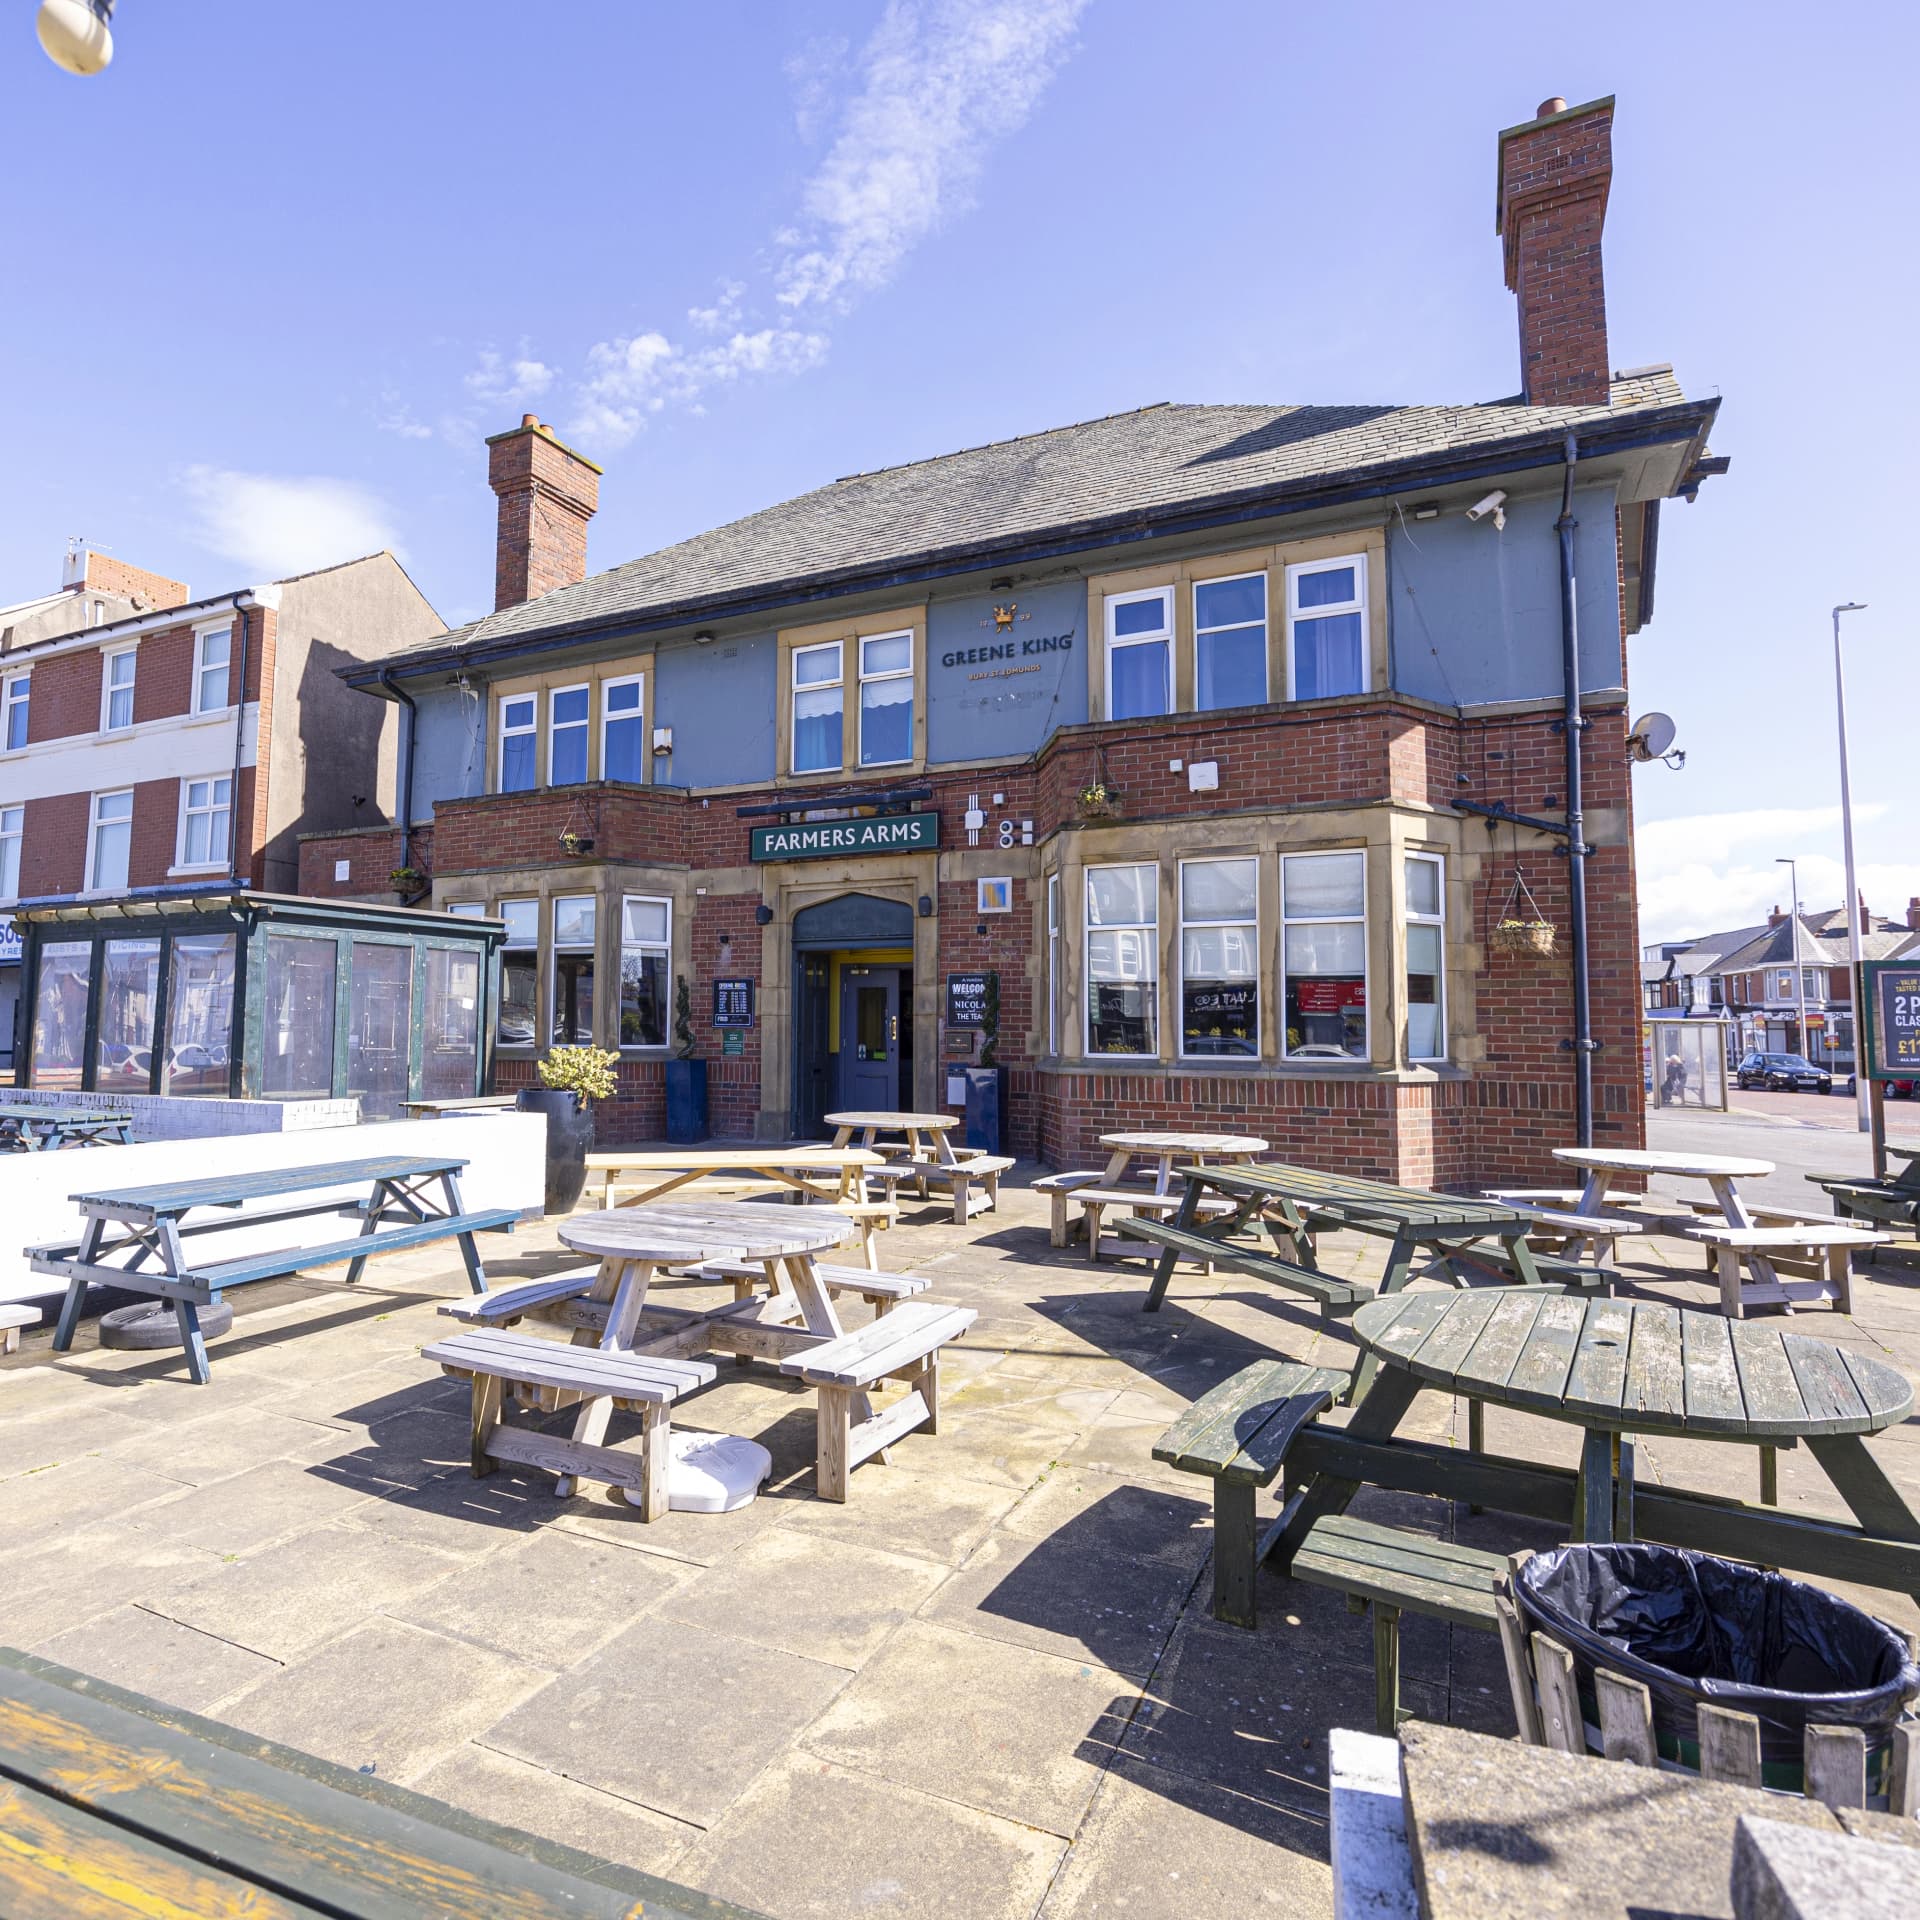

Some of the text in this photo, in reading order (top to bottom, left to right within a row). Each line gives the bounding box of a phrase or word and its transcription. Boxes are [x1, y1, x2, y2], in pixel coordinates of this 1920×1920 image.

[942, 634, 1072, 668] GREENE KING
[765, 822, 921, 852] FARMERS ARMS
[957, 1012, 969, 1020] THE
[1895, 996, 1907, 1014] 2
